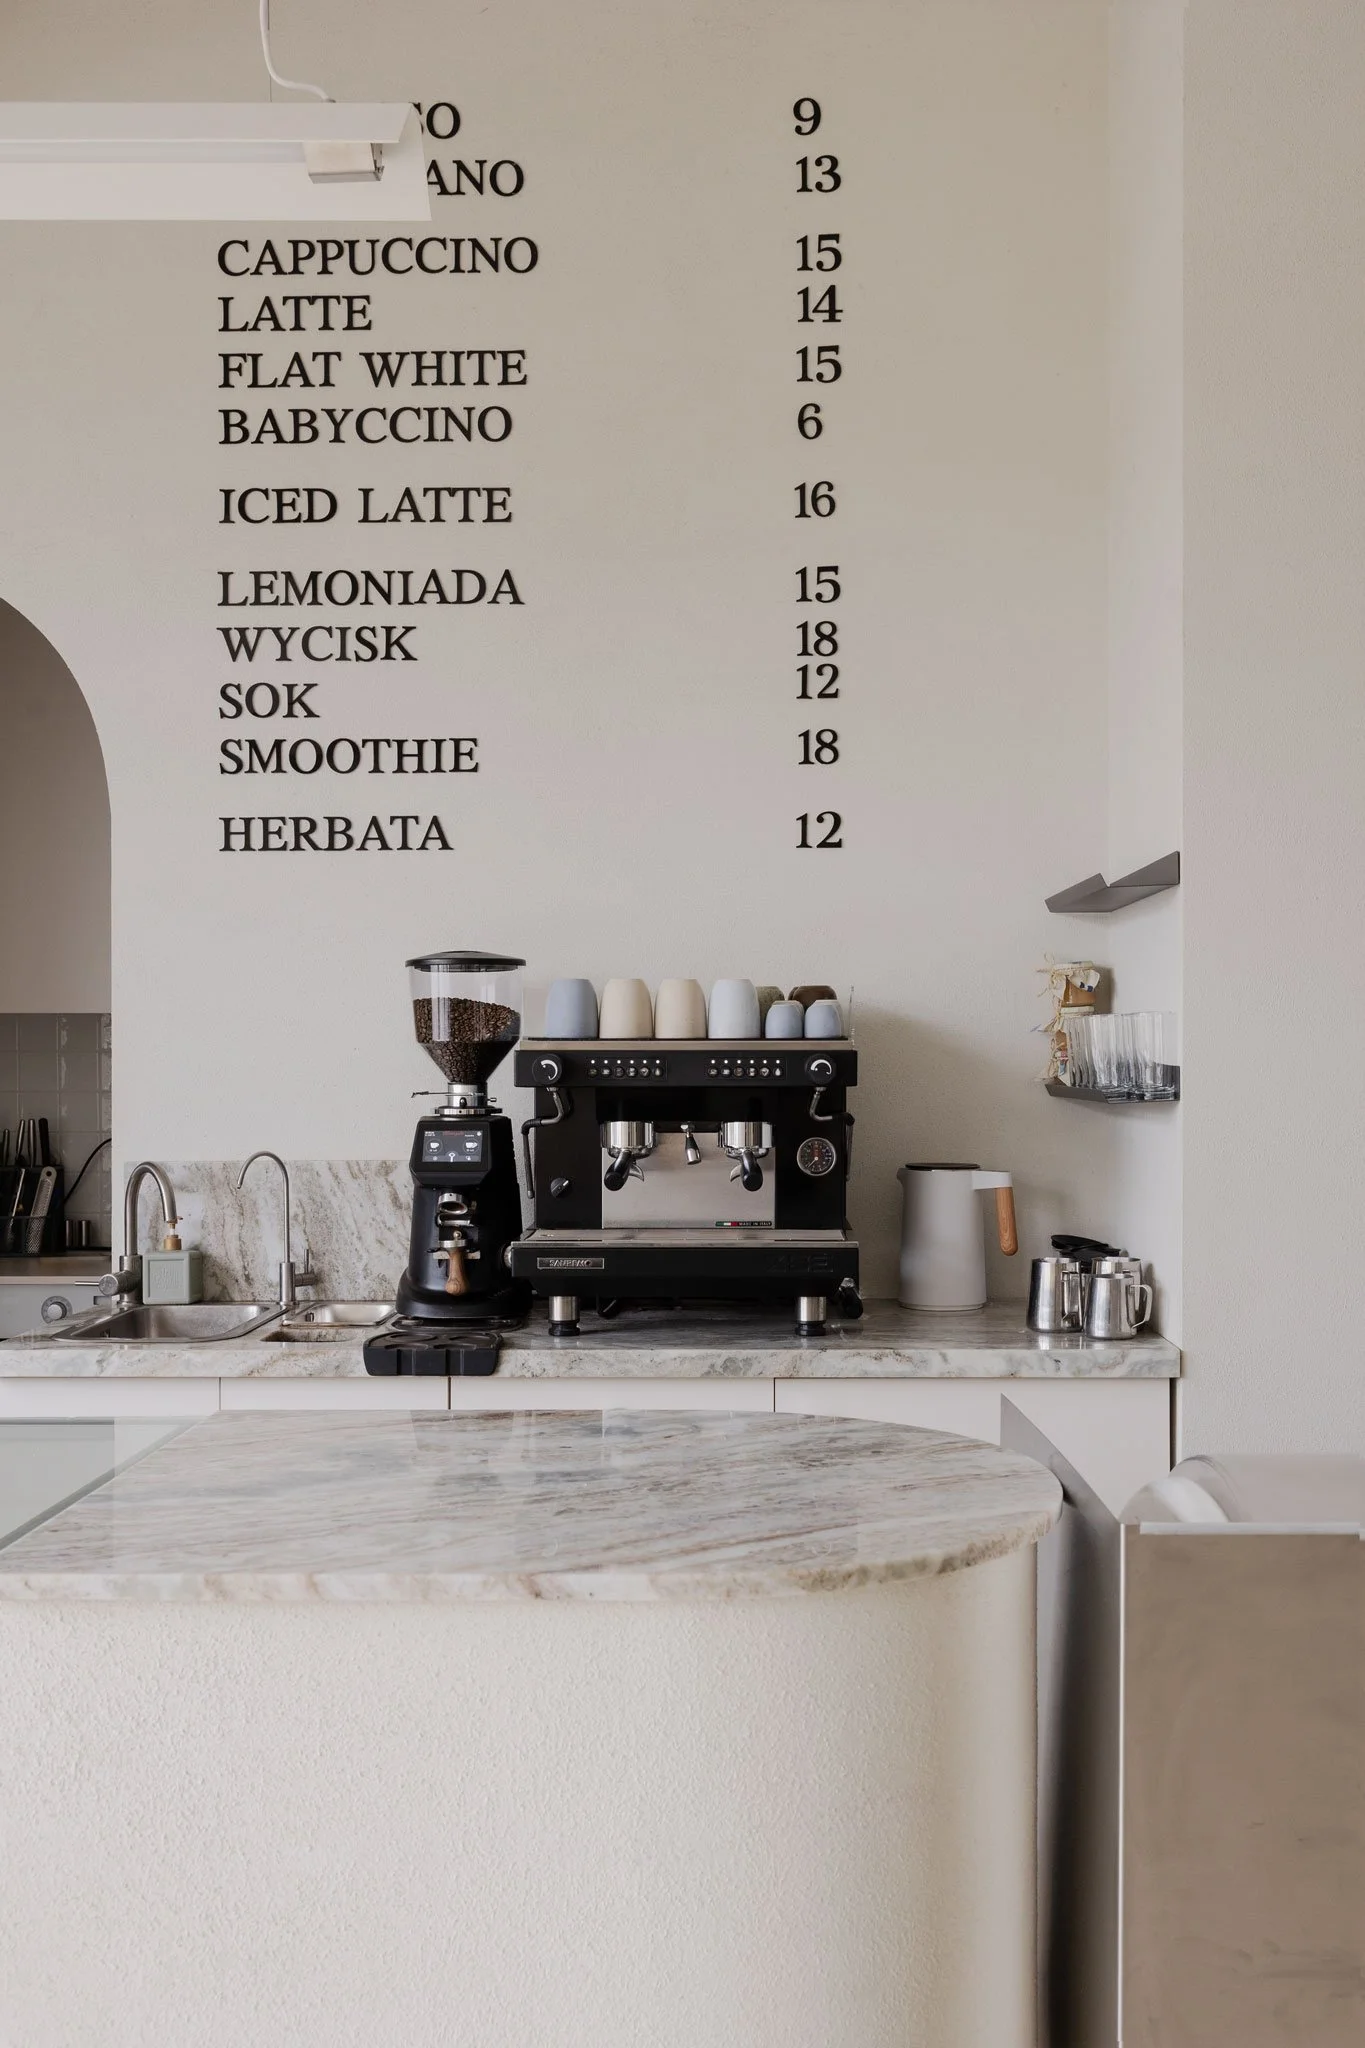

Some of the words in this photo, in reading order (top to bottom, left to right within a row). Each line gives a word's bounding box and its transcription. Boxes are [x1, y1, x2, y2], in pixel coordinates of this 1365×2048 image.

[793, 97, 822, 136] 9
[795, 155, 842, 194] 13
[217, 236, 539, 276] CAPPUCCINO
[796, 233, 843, 272] 15
[217, 294, 373, 332] LATTE
[796, 284, 843, 323] 14
[217, 351, 342, 389] FLAT
[358, 349, 528, 387] WHITE
[795, 344, 843, 383] 15
[217, 405, 513, 445] BABYCCINO
[797, 402, 824, 440] 6
[218, 487, 338, 524] ICED
[357, 486, 513, 524] LATTE
[794, 480, 837, 519] 16
[217, 568, 526, 607] LEMONIADA
[795, 565, 842, 604] 15
[216, 625, 418, 663] WYCISK
[796, 620, 839, 657] 18
[218, 682, 321, 720] SOK
[795, 663, 840, 700] 12
[218, 737, 479, 774] SMOOTHIE
[797, 728, 840, 765] 18
[218, 815, 454, 852] HERBATA
[795, 810, 843, 849] 12
